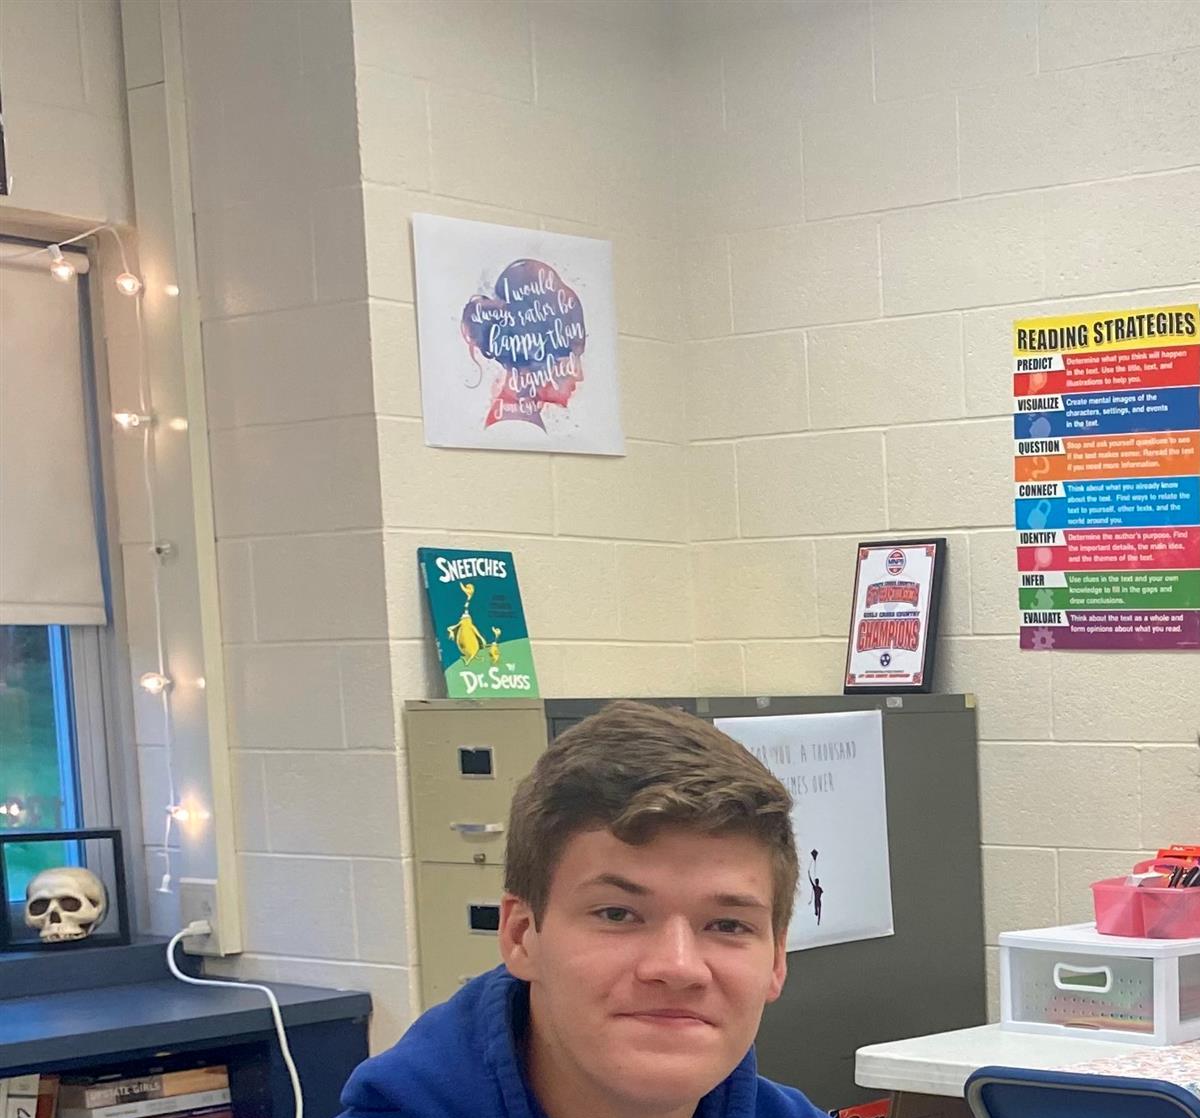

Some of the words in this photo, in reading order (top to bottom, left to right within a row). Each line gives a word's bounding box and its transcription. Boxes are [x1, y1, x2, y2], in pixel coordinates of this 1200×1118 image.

[504, 278, 510, 304] I
[512, 268, 557, 300] would
[471, 302, 516, 327] always
[519, 301, 555, 326] rather
[557, 289, 576, 315] be
[1017, 325, 1088, 350] READING
[1093, 312, 1196, 344] STRATEGIES
[488, 323, 548, 362] happy
[547, 321, 584, 349] than
[1017, 357, 1053, 371] PREDICT
[508, 352, 578, 398] dignified
[1018, 397, 1059, 411] VISUALIZE
[1018, 440, 1060, 453] QUESTION
[1019, 484, 1058, 497] CONNECT
[1020, 532, 1057, 544] IDENTIFY
[435, 557, 508, 583] SNEETCHES
[1022, 575, 1044, 586] INFER
[1024, 612, 1061, 624] EVALUATE
[858, 620, 920, 651] CHAMPIONS
[459, 671, 489, 694] Dr.
[488, 666, 531, 691] Seuss
[810, 741, 856, 761] THOUSAND
[813, 772, 834, 792] OVER
